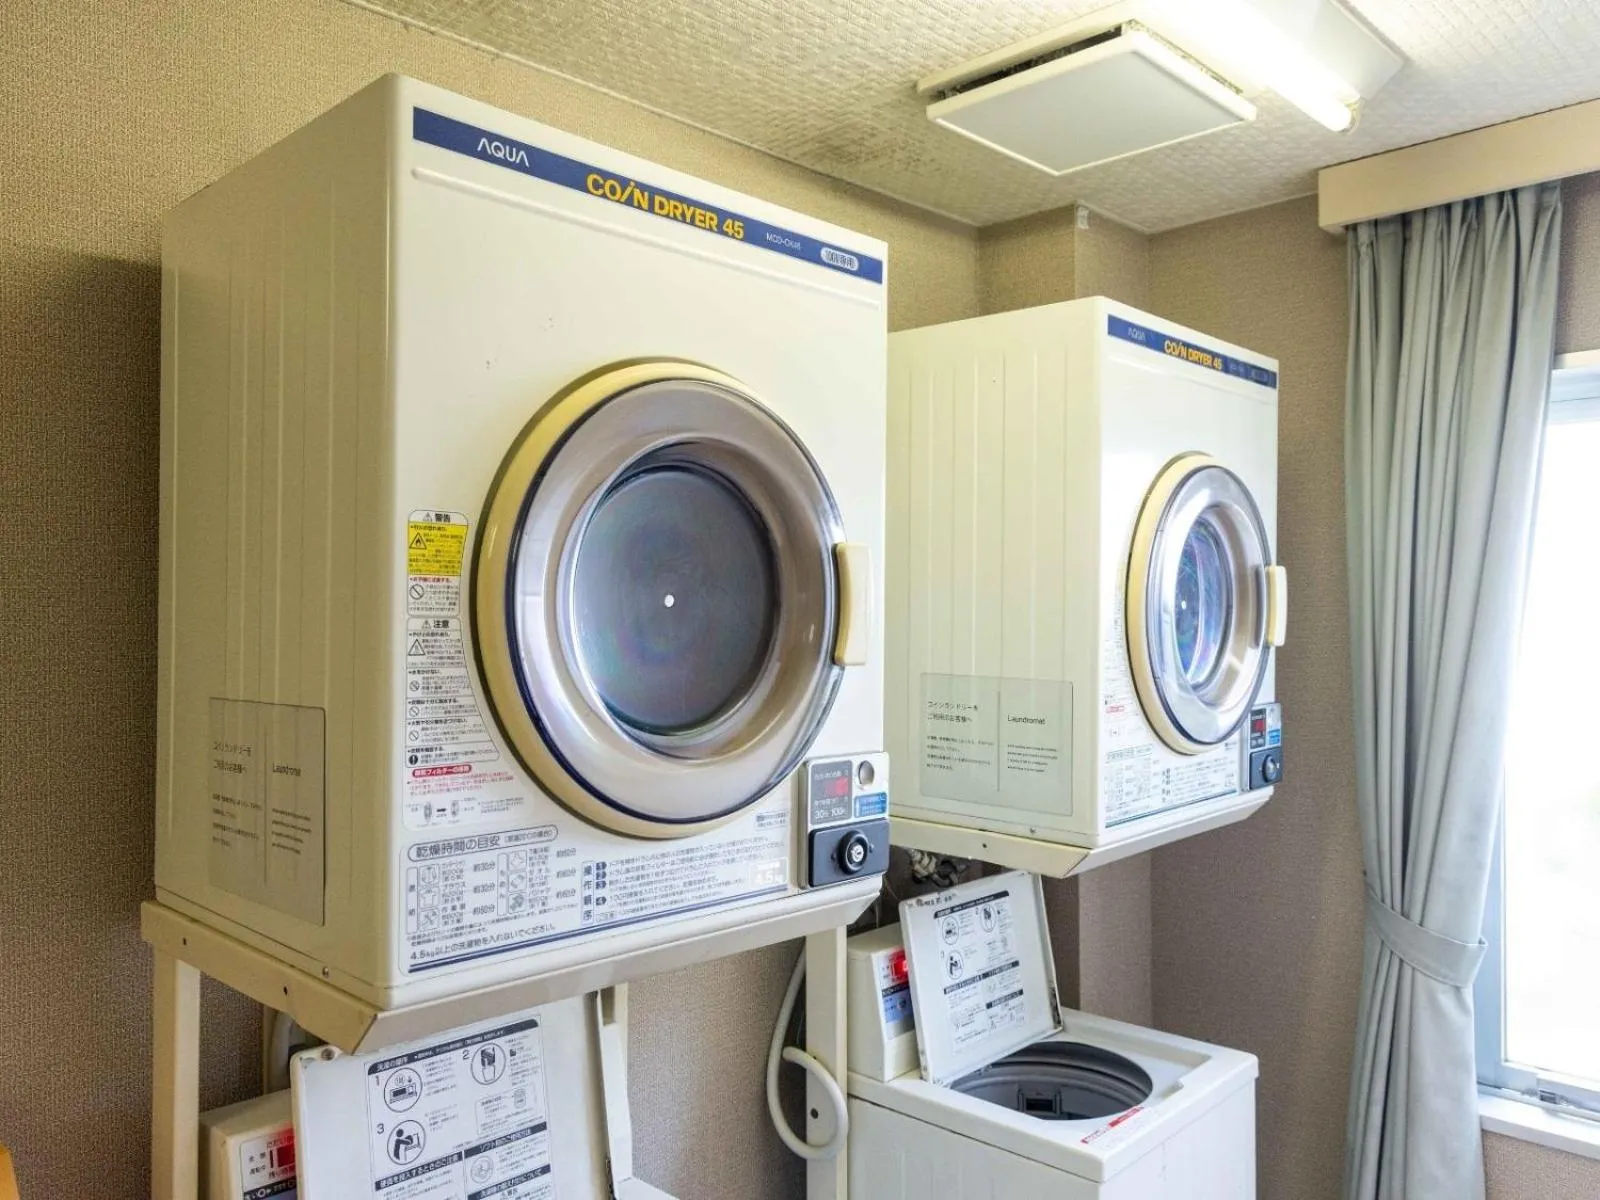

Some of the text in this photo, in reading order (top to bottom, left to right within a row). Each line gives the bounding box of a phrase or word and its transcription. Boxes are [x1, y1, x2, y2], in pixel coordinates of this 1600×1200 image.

[477, 137, 529, 167] AQUA
[586, 174, 745, 240] COIN DRYER 45
[1128, 328, 1146, 342] AQUA
[1164, 340, 1187, 360] COIN
[1187, 349, 1213, 367] DRYER
[1213, 357, 1223, 371] 45
[435, 513, 451, 523] 警告
[433, 619, 449, 629] 注意
[1007, 714, 1046, 726] Laundromat
[416, 835, 500, 858] 乾燥時間の目安
[462, 1050, 470, 1060] 2
[375, 1076, 380, 1086] 1
[377, 1123, 385, 1134] 3
